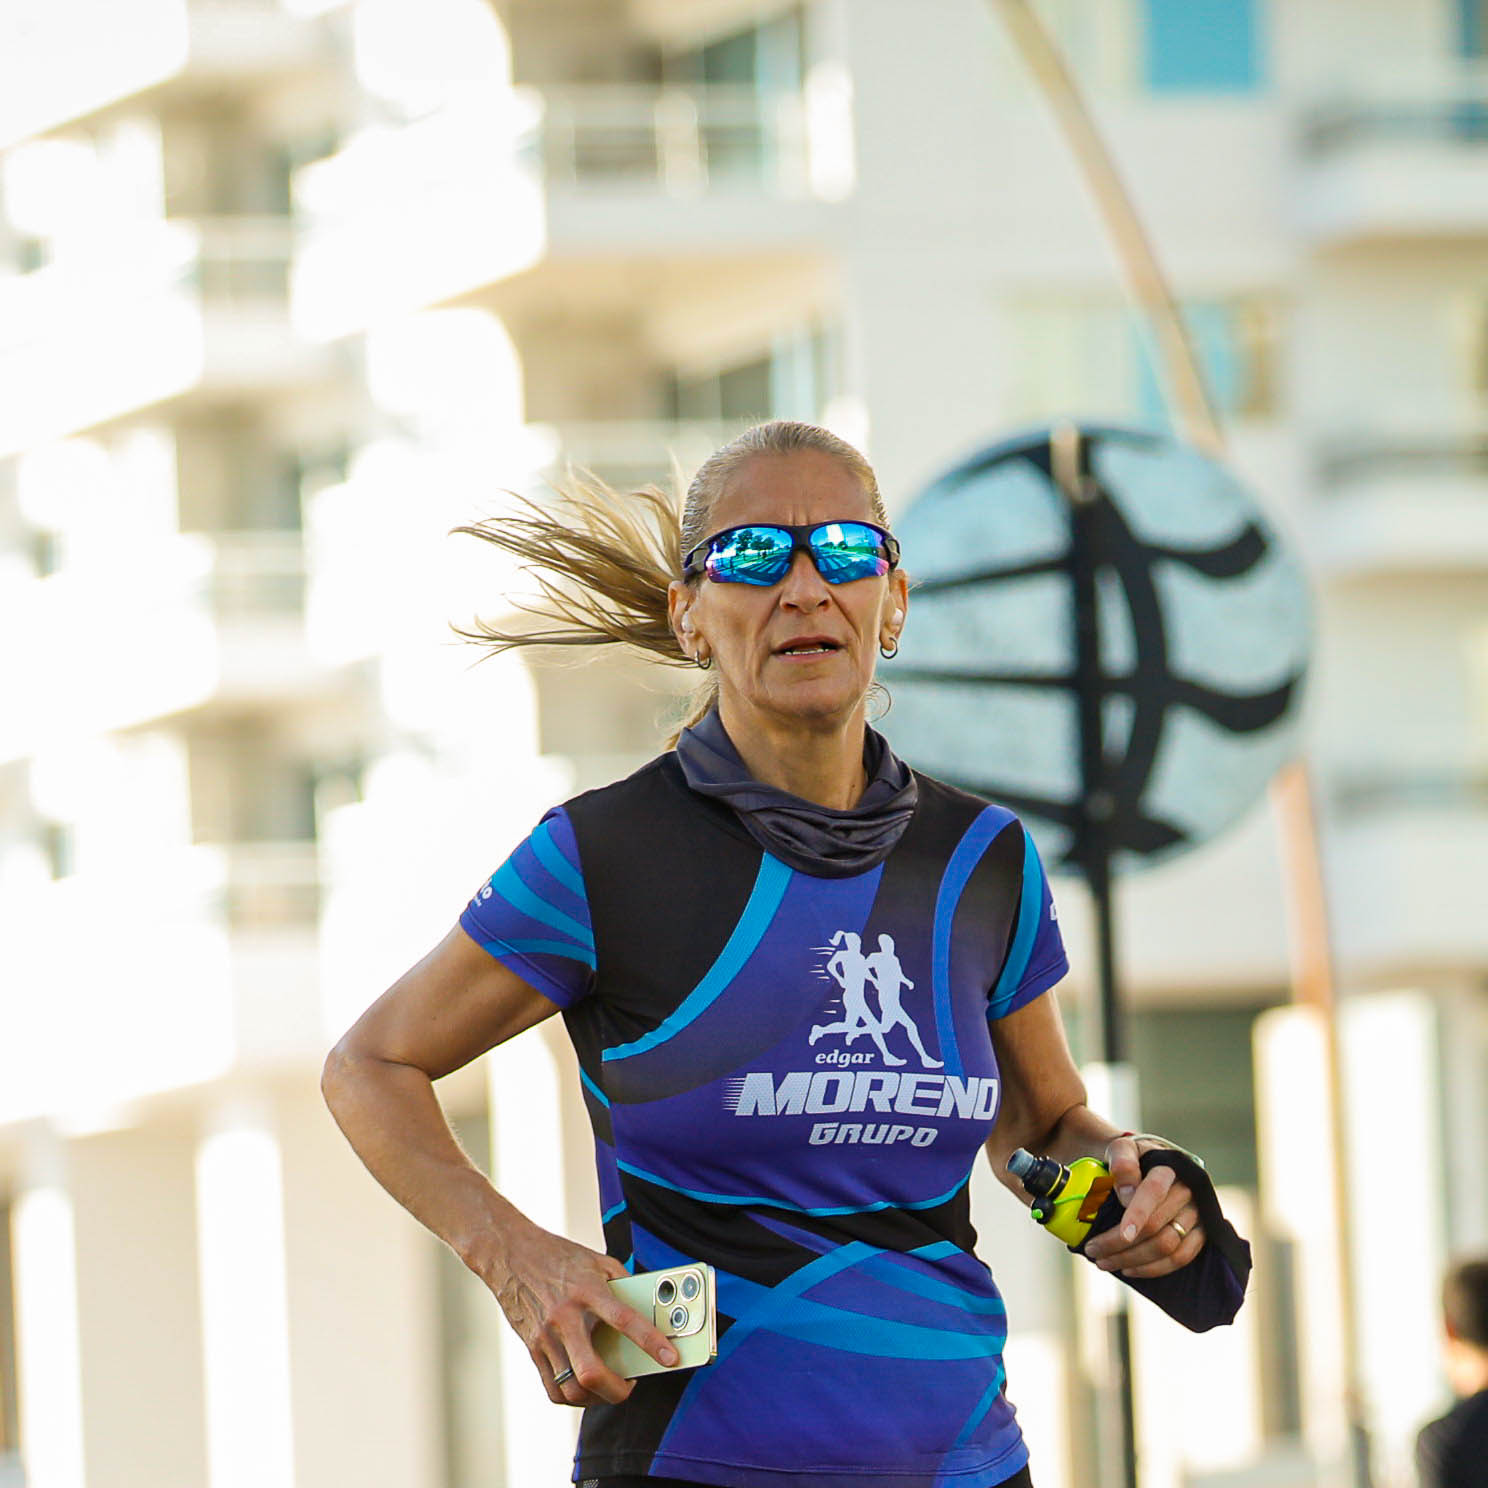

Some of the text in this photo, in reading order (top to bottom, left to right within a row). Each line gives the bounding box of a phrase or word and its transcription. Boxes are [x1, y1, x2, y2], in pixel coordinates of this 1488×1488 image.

[815, 1049, 875, 1068] edgar
[735, 1071, 999, 1120] MORENO
[808, 1122, 939, 1147] GRUPO
